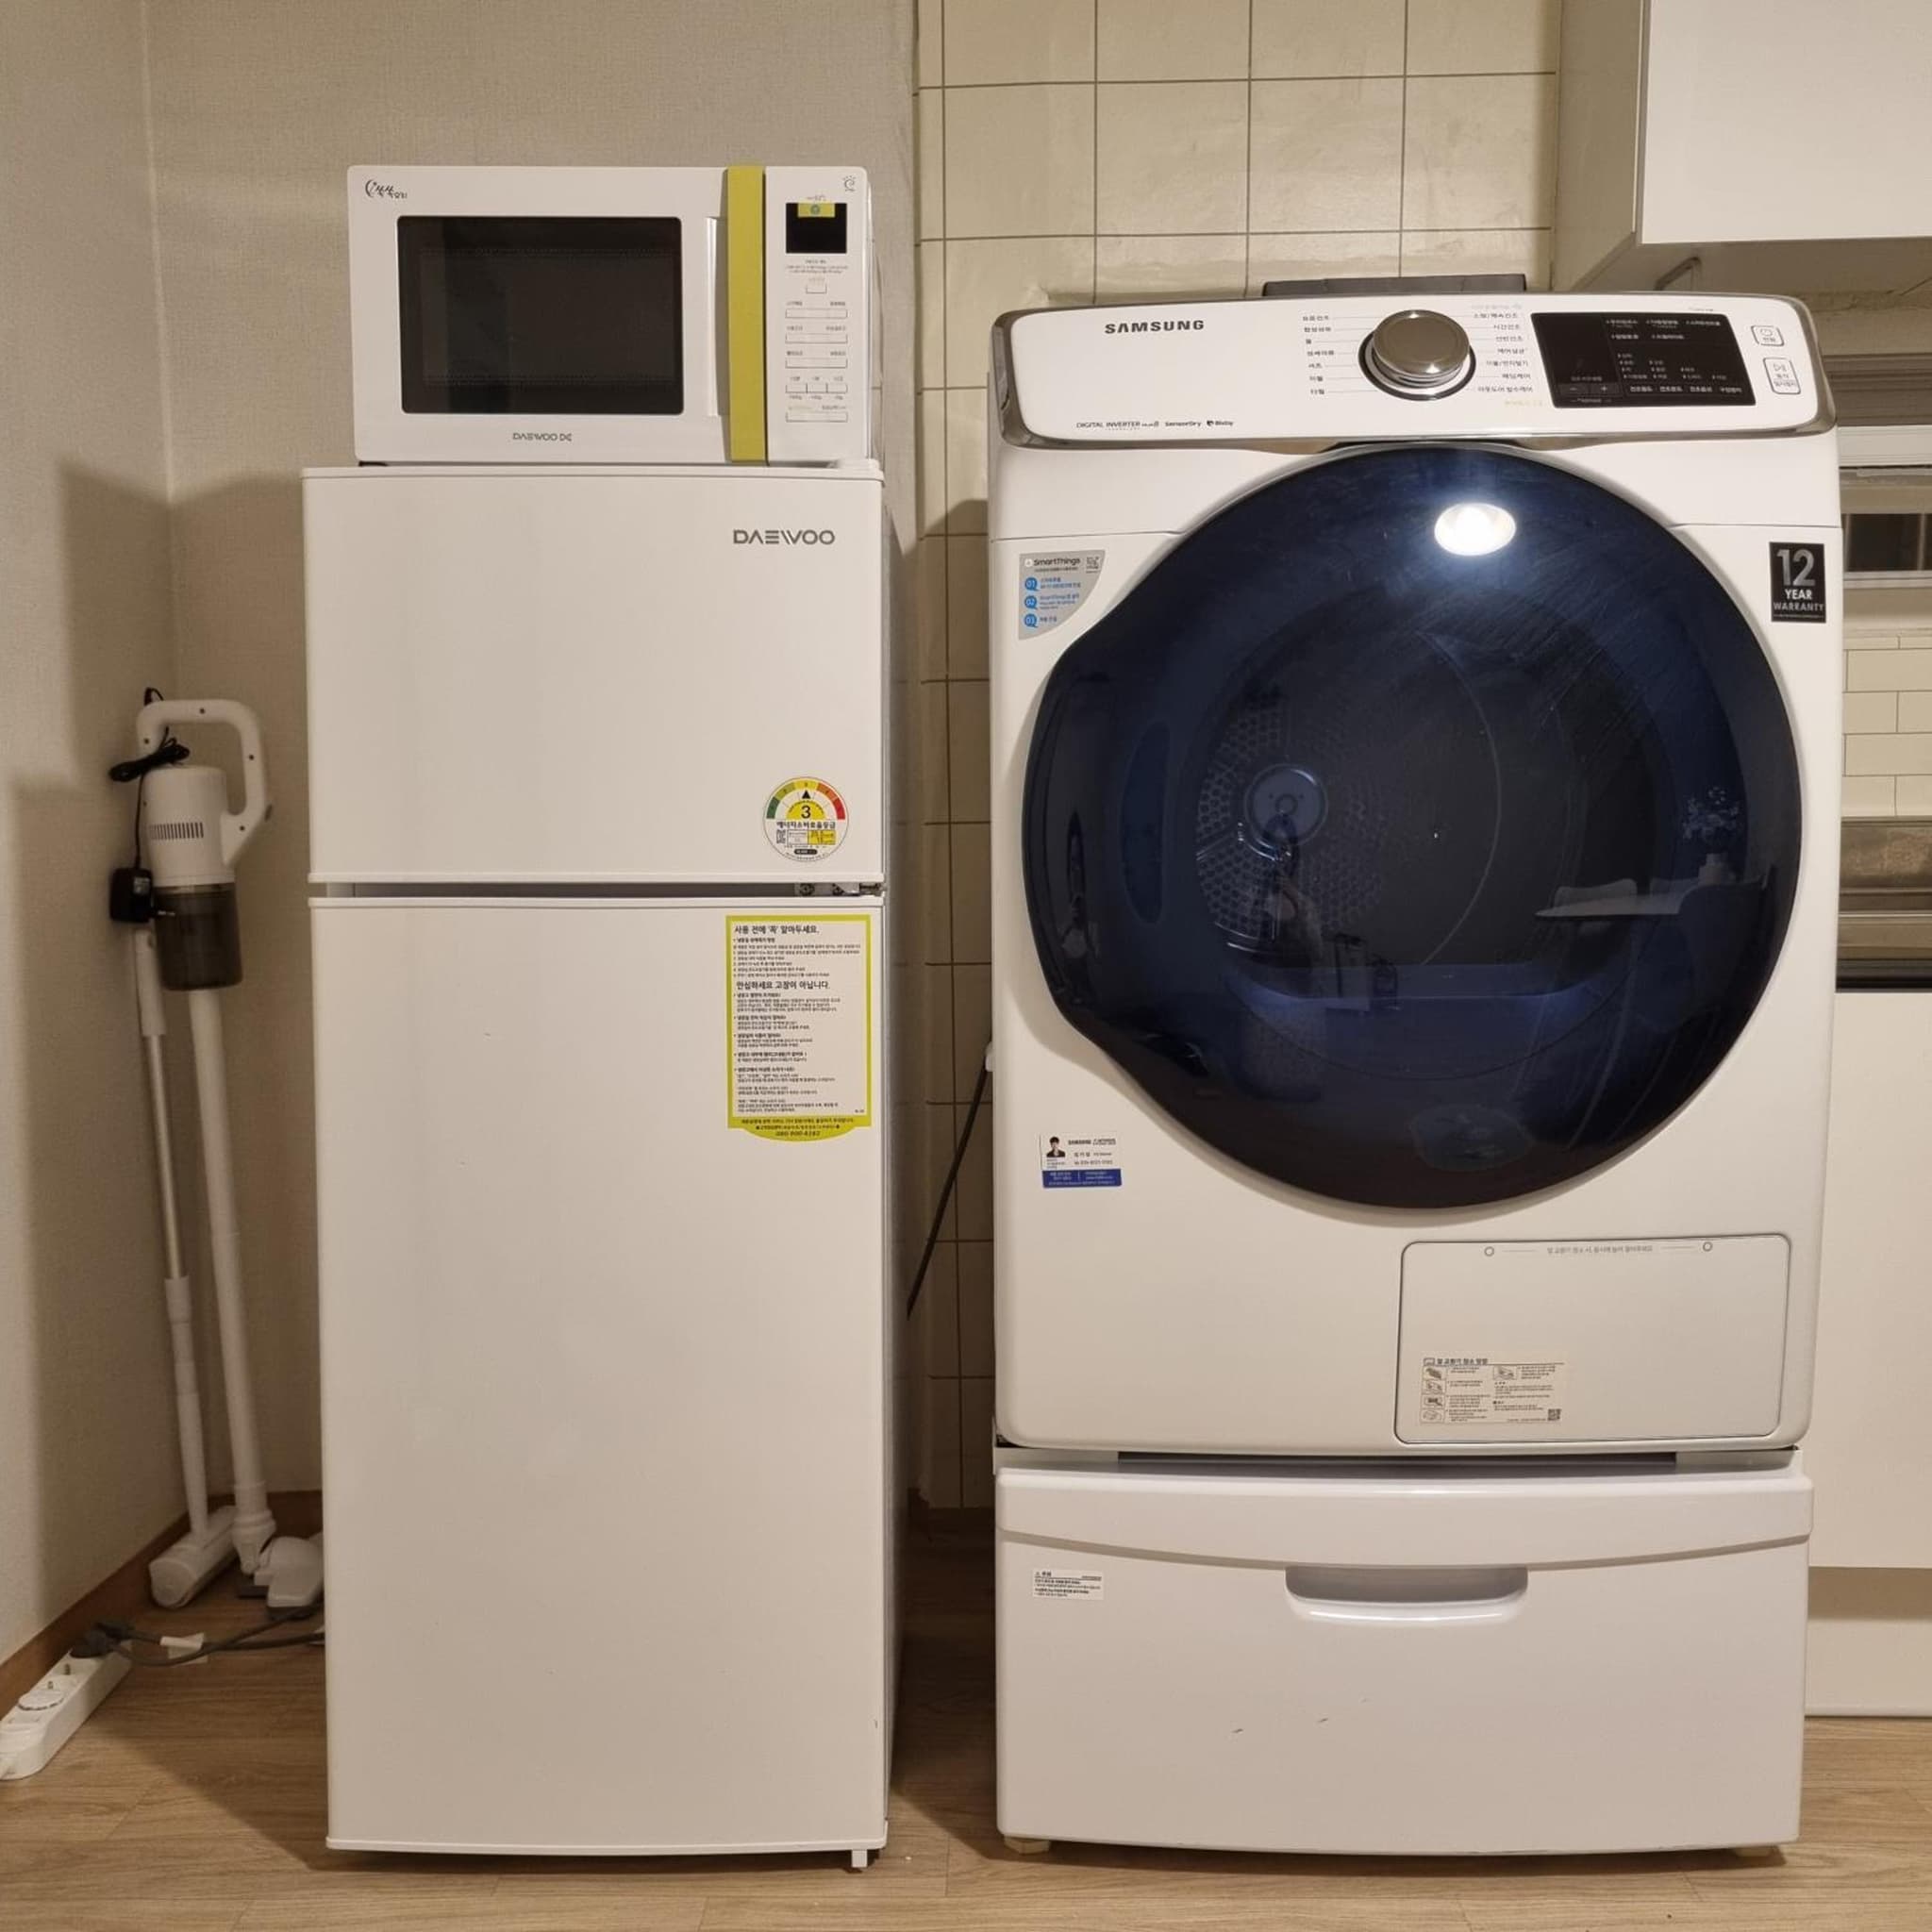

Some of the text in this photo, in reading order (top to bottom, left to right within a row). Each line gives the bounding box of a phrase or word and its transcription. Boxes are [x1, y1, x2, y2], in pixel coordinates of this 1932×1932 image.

[1105, 320, 1205, 334] SAMSUNG
[512, 432, 558, 441] DAEWOO
[733, 529, 836, 545] DAEWOO
[1034, 558, 1080, 566] SmartThings
[1776, 549, 1816, 587] 12
[1785, 589, 1813, 600] YEAR
[1773, 602, 1824, 611] WARRANTY
[800, 805, 811, 819] 3
[735, 925, 749, 934] 사용
[751, 925, 766, 934] 전에
[736, 981, 774, 991] 안심하세요
